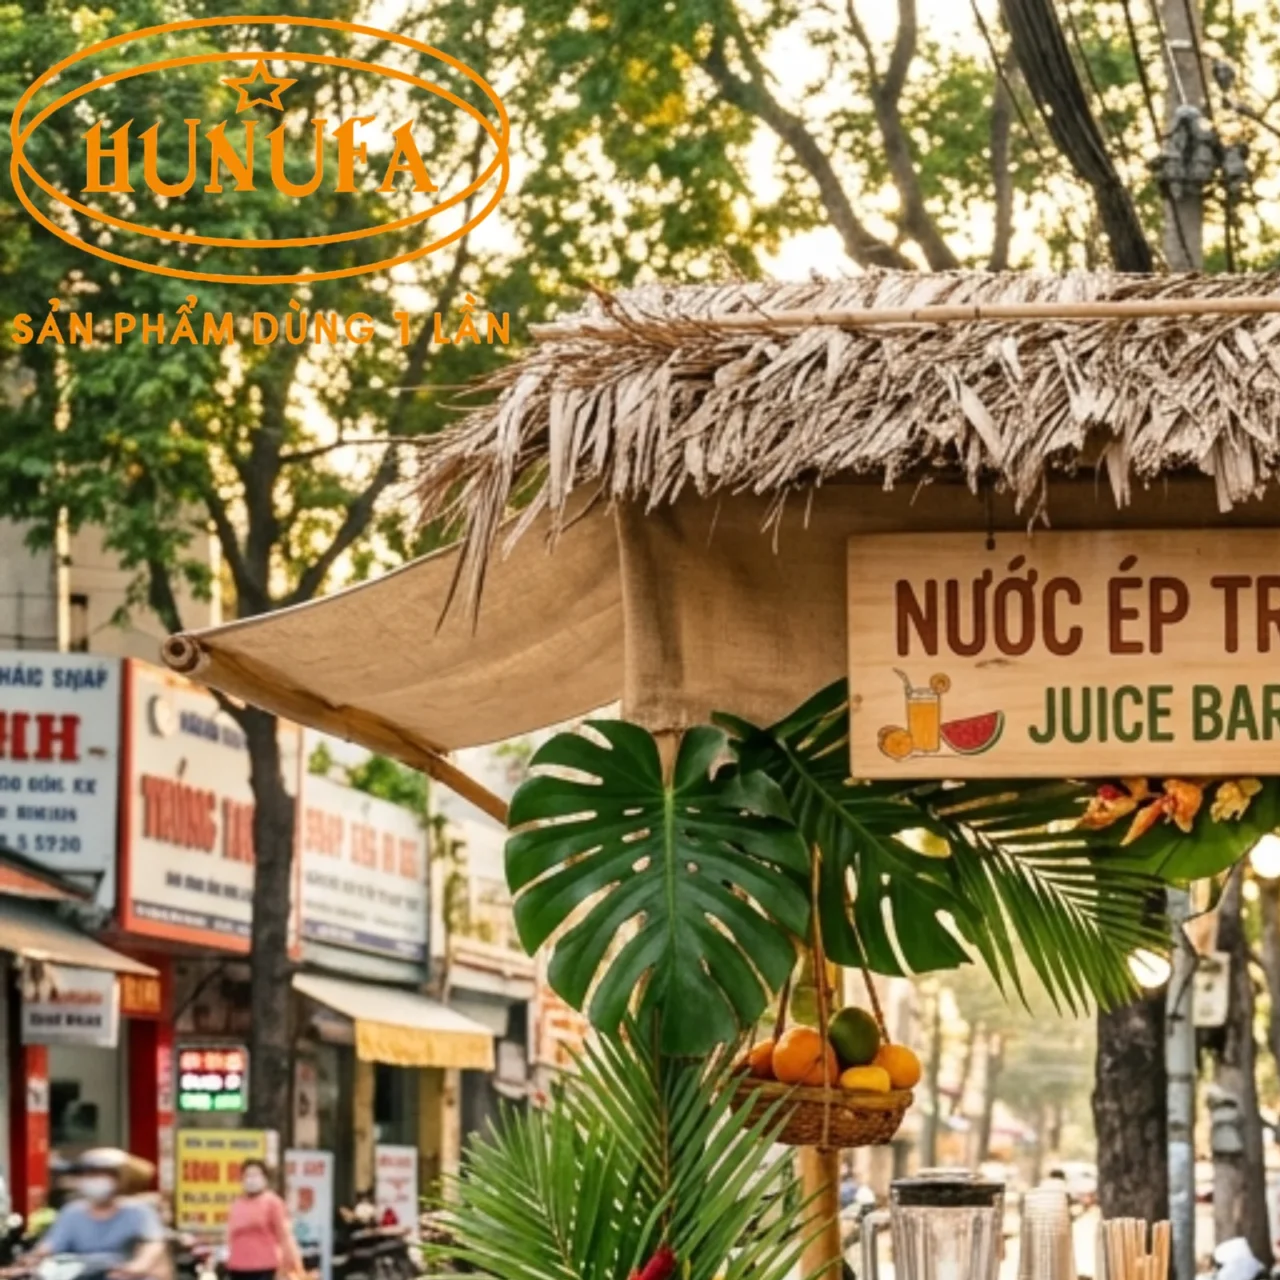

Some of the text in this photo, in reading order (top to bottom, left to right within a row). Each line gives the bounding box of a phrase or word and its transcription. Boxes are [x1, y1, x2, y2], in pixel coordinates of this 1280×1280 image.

[895, 555, 1083, 656] NƯỚC
[1108, 555, 1190, 655] ÉP
[1028, 684, 1173, 744] JUICE
